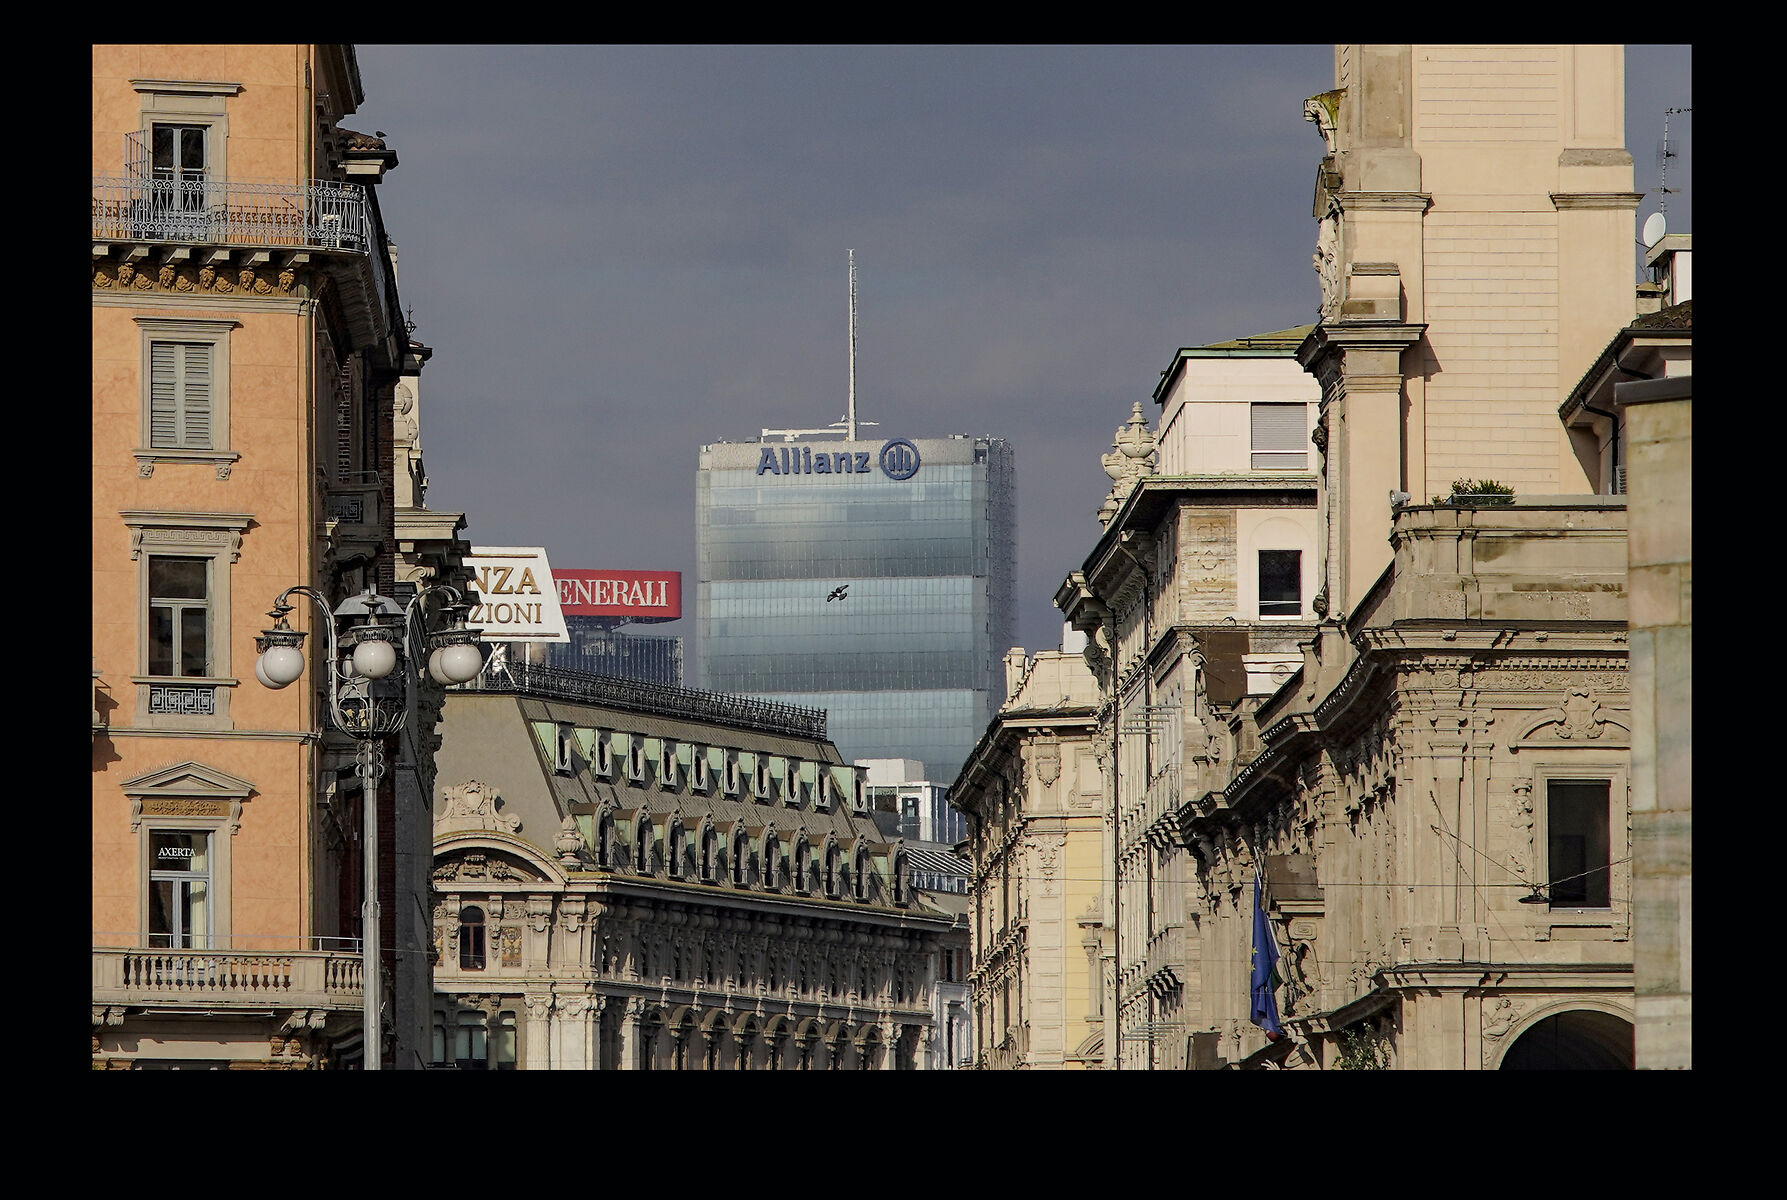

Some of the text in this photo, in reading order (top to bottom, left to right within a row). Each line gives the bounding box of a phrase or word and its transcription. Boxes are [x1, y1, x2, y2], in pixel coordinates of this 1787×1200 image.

[756, 446, 871, 475] Allianz
[554, 578, 669, 607] ENERALI
[469, 602, 542, 624] ZIONI
[158, 847, 196, 856] AXERTA
